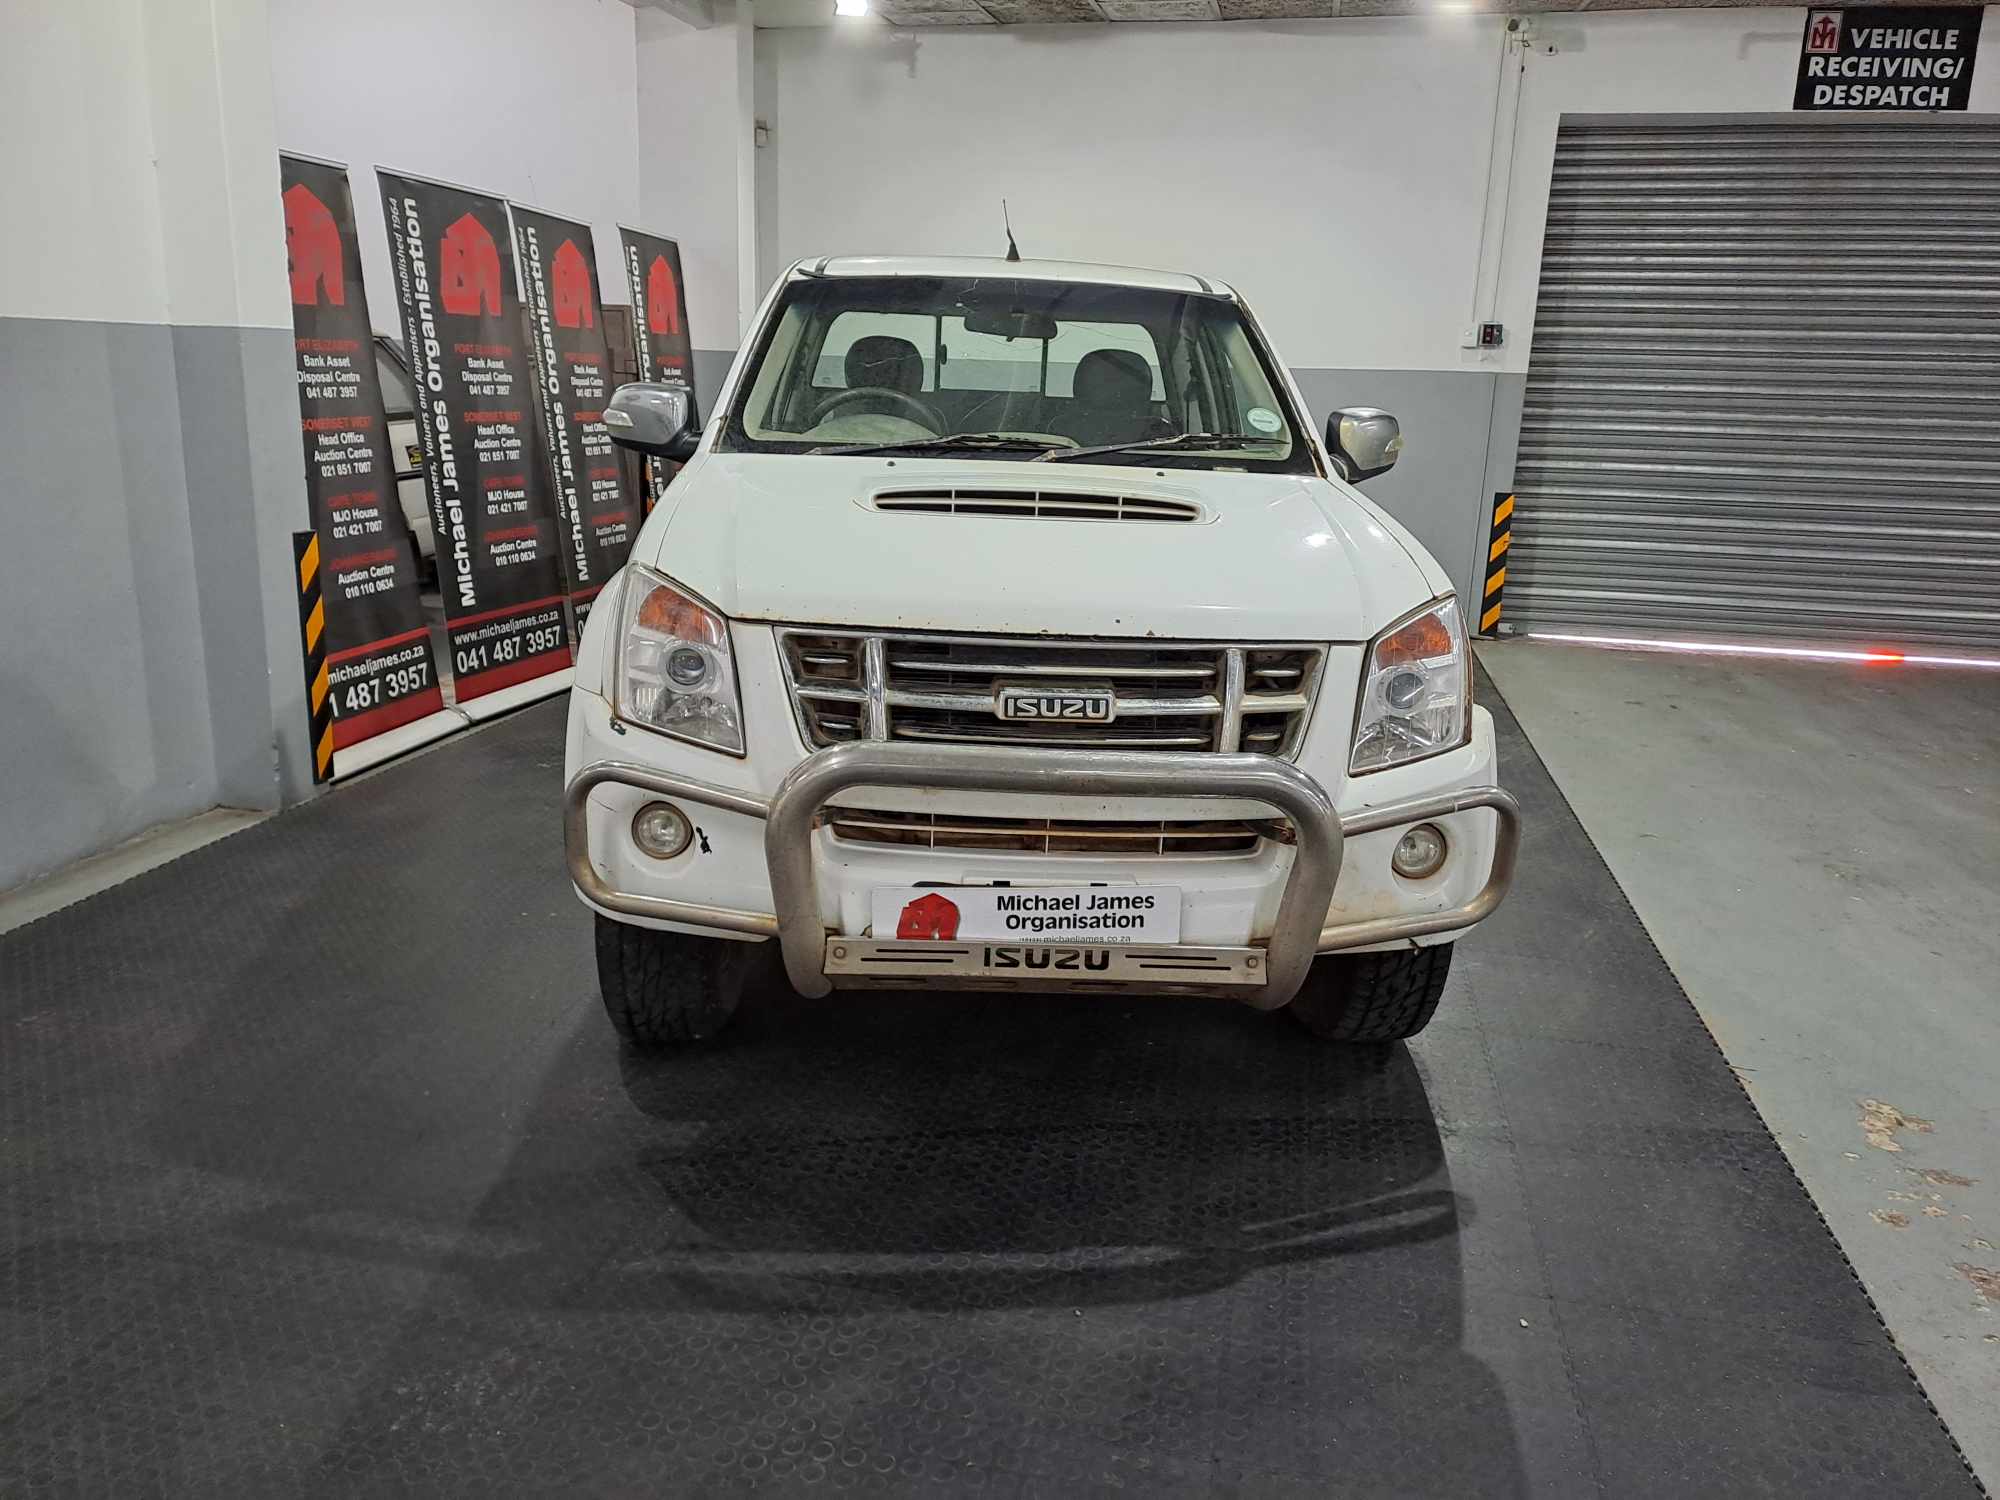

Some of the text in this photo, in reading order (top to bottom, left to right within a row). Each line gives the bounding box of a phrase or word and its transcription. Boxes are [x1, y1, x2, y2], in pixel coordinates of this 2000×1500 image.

[1851, 28, 1960, 50] VEHICLE
[1807, 56, 1965, 79] RECEIVING/
[1813, 84, 1950, 107] DESPATCH
[389, 197, 402, 229] 1964
[393, 232, 412, 306] Established
[527, 227, 559, 394] Organisation
[630, 246, 652, 382] rganisation
[408, 317, 424, 382] Appraisers
[303, 354, 351, 367] Bank Asset
[467, 358, 485, 369] Bank
[297, 370, 360, 384] Disposal Centre
[462, 371, 513, 383] Disposal Centre
[306, 386, 357, 398] 041 487 3957
[416, 384, 428, 409] and
[469, 385, 481, 395] 041
[404, 198, 476, 607] Michael James Organisation
[318, 431, 365, 445] Head Office
[422, 412, 435, 456] Valuers
[477, 424, 515, 435] Head Office
[474, 438, 522, 449] Auction Centre
[554, 402, 574, 482] James
[314, 447, 373, 462] Auction Centre
[480, 452, 491, 462] 021
[321, 464, 336, 477] 021
[353, 461, 371, 473] 7007
[430, 462, 447, 535] Auctioneers,
[487, 490, 525, 501] MJO House
[333, 508, 378, 522] MJO House
[487, 504, 499, 515] 021
[333, 520, 382, 538] 021 421 7007
[565, 488, 590, 581] Michael
[490, 540, 537, 555] Auction Centre
[495, 556, 507, 566] 010
[508, 554, 519, 564] 110
[338, 565, 395, 584] Auction Centre
[345, 586, 360, 598] 010
[360, 582, 375, 595] 110
[454, 610, 559, 646] www.michaeljames.co.za
[457, 645, 488, 674] 041
[493, 636, 521, 662] 487
[526, 625, 560, 653] 3957
[328, 645, 424, 686] michaeljames.co.za
[346, 678, 380, 710] 487
[386, 662, 427, 697] 3957
[1007, 698, 1107, 717] ISUZU
[997, 894, 1155, 911] Michael James
[1005, 912, 1145, 932] Organisation
[983, 947, 1110, 971] ISUZU
